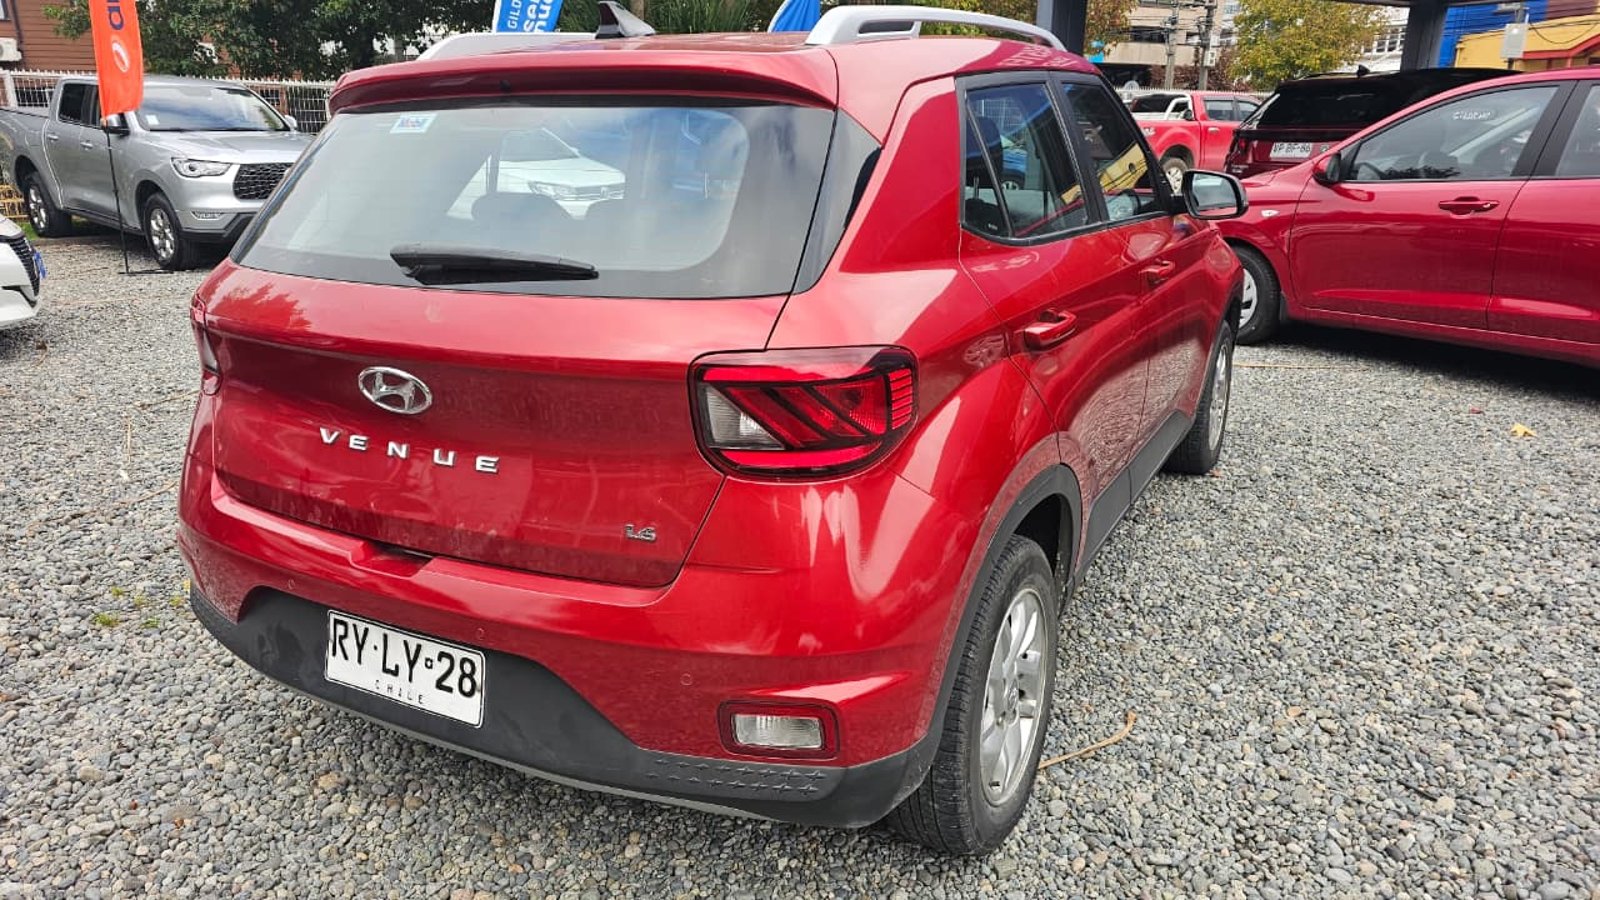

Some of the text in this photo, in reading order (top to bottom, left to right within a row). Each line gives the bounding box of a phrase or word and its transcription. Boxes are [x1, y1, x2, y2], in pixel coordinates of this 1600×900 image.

[523, 0, 540, 32] se
[319, 427, 500, 473] VENUE
[375, 679, 429, 705] CHILE
